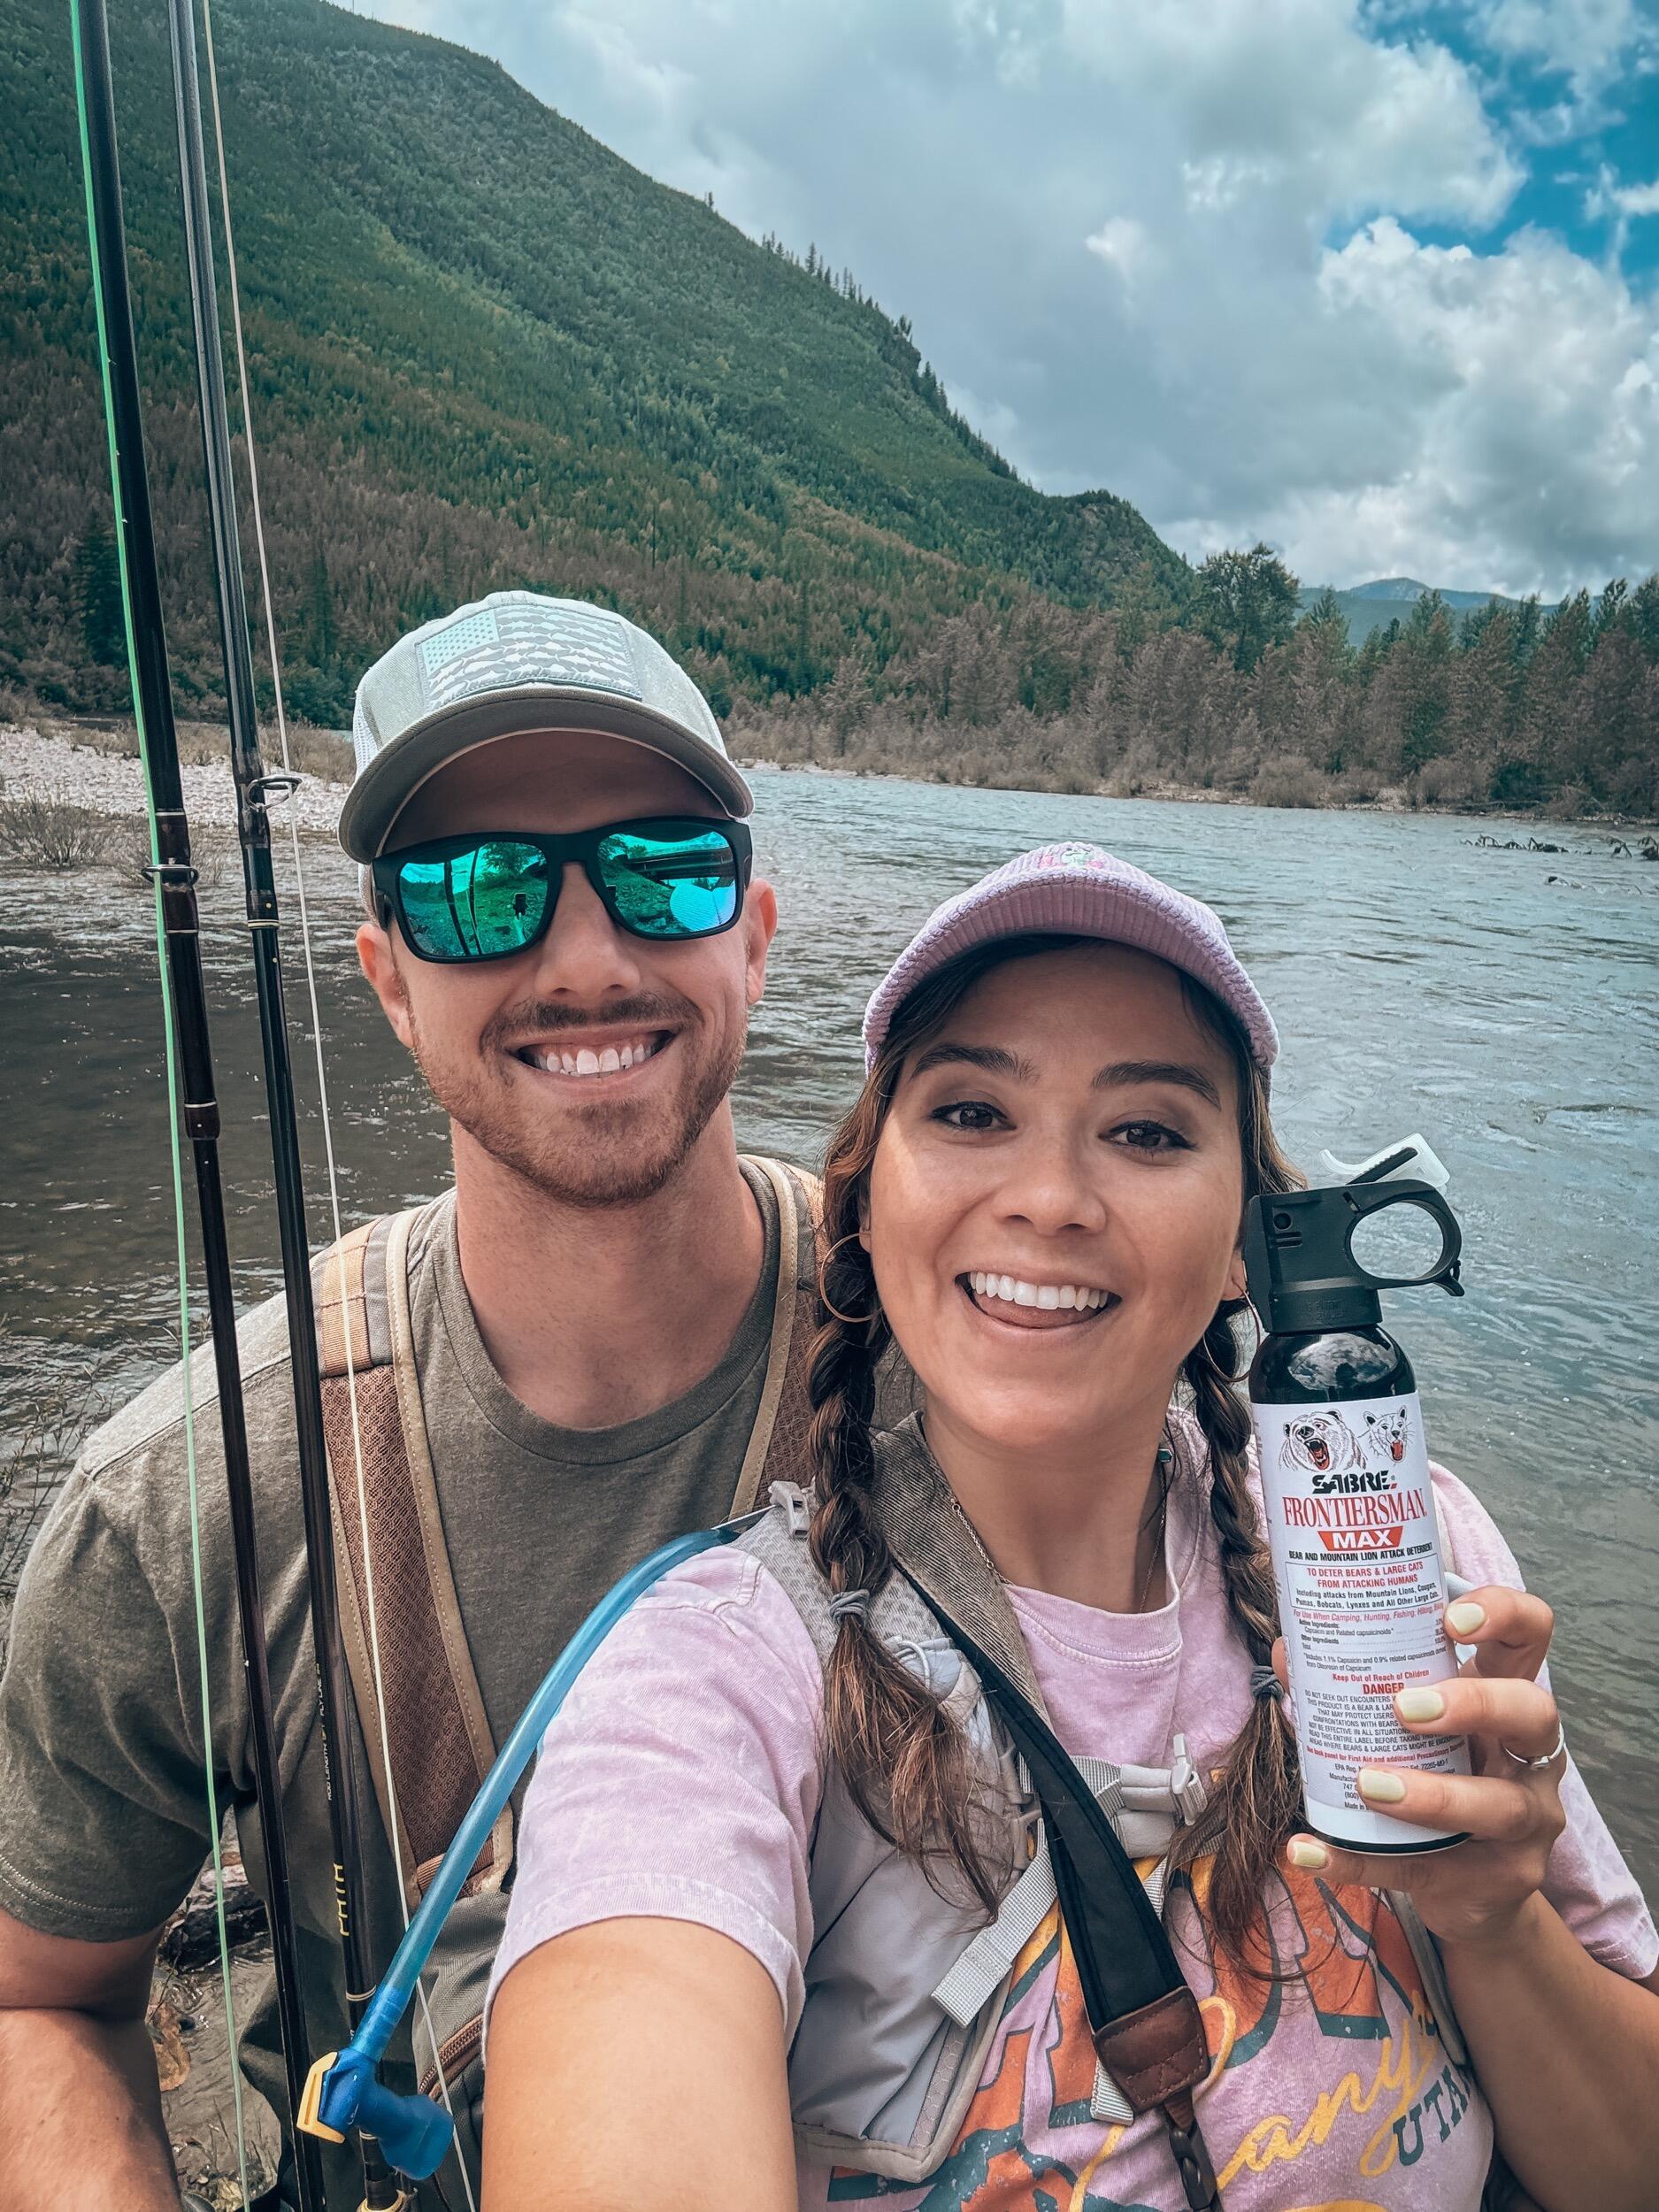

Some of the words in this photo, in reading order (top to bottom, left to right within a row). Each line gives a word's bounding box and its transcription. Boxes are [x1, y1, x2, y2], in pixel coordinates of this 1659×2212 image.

[1312, 1471, 1391, 1494] SABRE
[1282, 1488, 1425, 1527] FRONTIERSMAN
[1333, 1530, 1394, 1549] MAX
[1289, 1550, 1302, 1560] BEAR
[1305, 1552, 1317, 1561] AND
[1320, 1553, 1358, 1562] MOUNTAIN
[1361, 1552, 1378, 1561] LION
[1380, 1548, 1405, 1559] ATTACK
[1407, 1542, 1432, 1555] DETERRENT
[1319, 1568, 1343, 1577] DETER
[1345, 1568, 1371, 1577] BEARS
[1375, 1567, 1380, 1576] &
[1383, 1564, 1407, 1575] LARGE
[1409, 1561, 1424, 1571] CATS
[1317, 1579, 1340, 1588] FROM
[1342, 1578, 1385, 1588] ATTACKING
[1387, 1574, 1418, 1586] HUMANS
[1296, 1588, 1321, 1599] Including
[1366, 1589, 1396, 1598] Mountain
[1399, 1586, 1417, 1595] Lions,
[1296, 1597, 1316, 1607] Pumas,
[1317, 1600, 1345, 1609] Bobcats,
[1346, 1601, 1370, 1609] Lynxes
[1415, 1594, 1429, 1602] Large
[1332, 1613, 1362, 1623] Camping,
[1394, 1609, 1416, 1618] Fishing,
[1333, 1673, 1348, 1682] Keep
[1373, 1672, 1394, 1681] Reach
[1404, 1670, 1429, 1678] Children
[1363, 1682, 1404, 1694] DANGER
[1307, 1697, 1317, 1706] THIS
[1312, 1715, 1359, 1727] CONFRONTATIONS
[1309, 1729, 1320, 1738] READ
[1320, 1732, 1332, 1740] THIS
[1333, 1734, 1353, 1743] ENTIRE
[1400, 1734, 1421, 1743] TAKING
[1325, 1725, 1352, 1735] EFFECTIVE
[1375, 1727, 1410, 1736] SITUATIONS
[1310, 1737, 1322, 1747] AREAS
[1314, 1747, 1324, 1756] back
[322, 1743, 331, 1780] LENGTH
[1393, 2065, 1471, 2166] UTA
